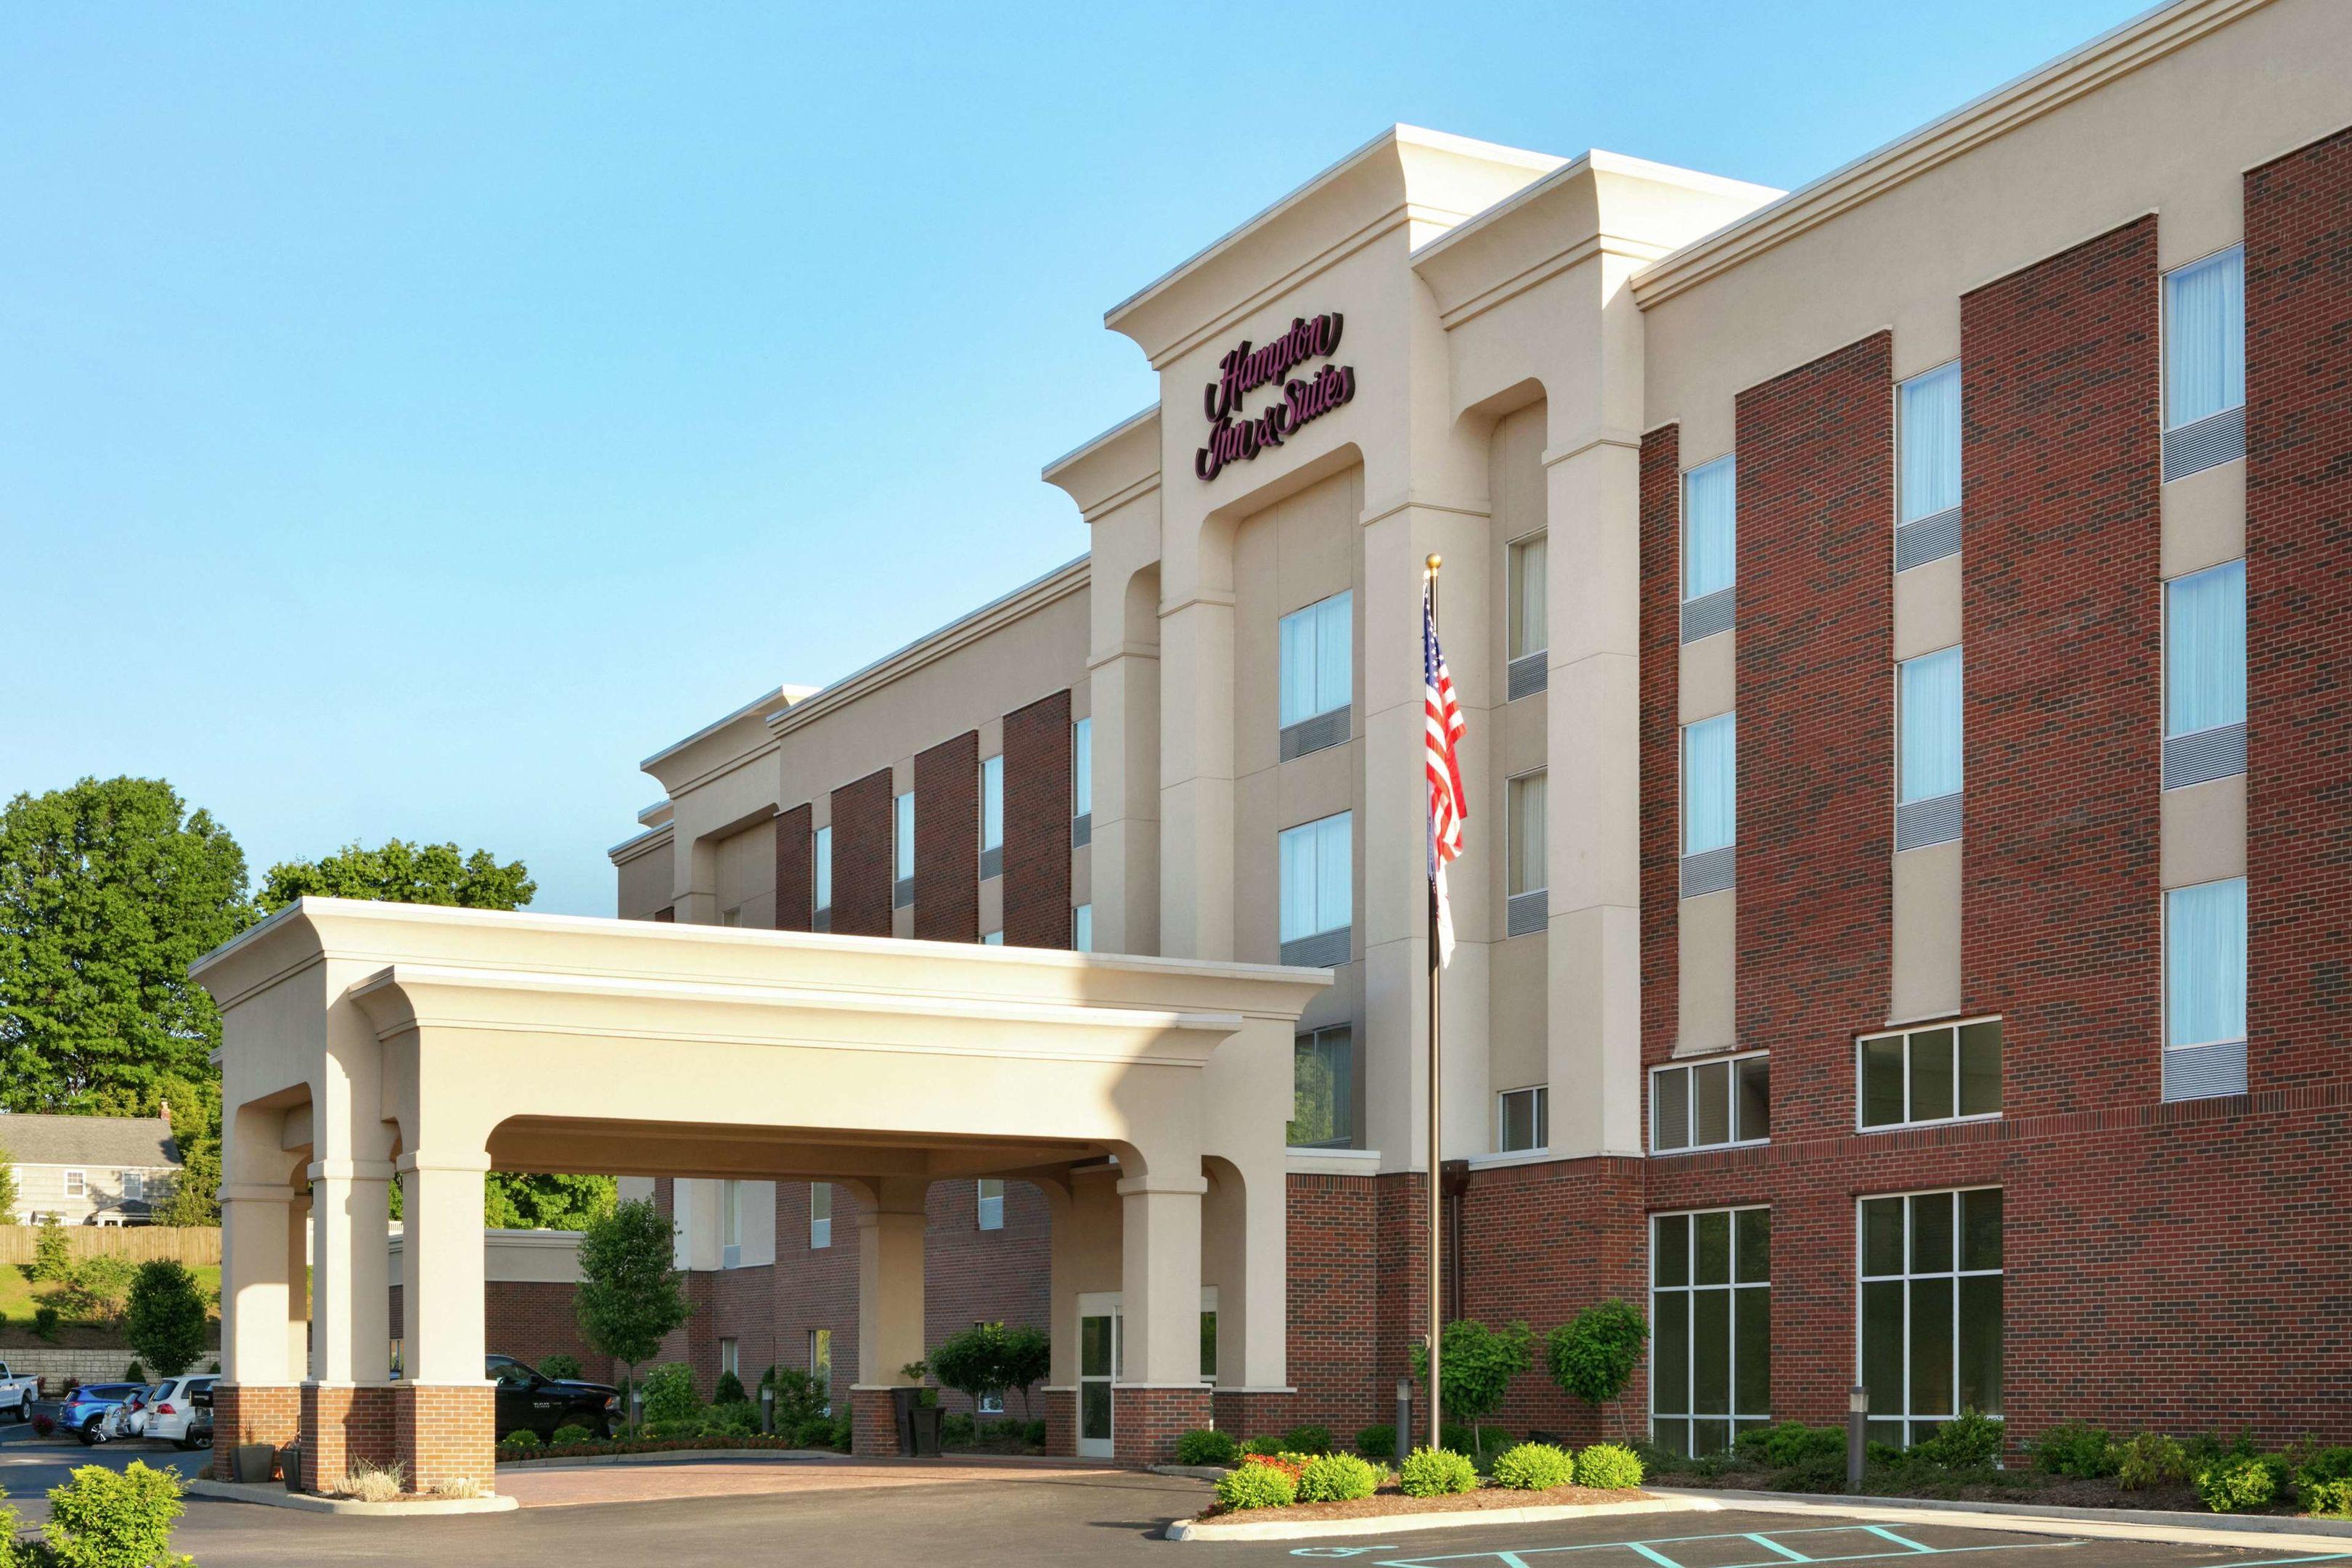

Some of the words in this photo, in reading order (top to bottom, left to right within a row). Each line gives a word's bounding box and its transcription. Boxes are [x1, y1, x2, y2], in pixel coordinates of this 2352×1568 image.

[1196, 417, 1263, 481] Inn
[1257, 407, 1284, 446] &
[1274, 364, 1355, 436] Suites
[1204, 312, 1343, 422] Hampton
